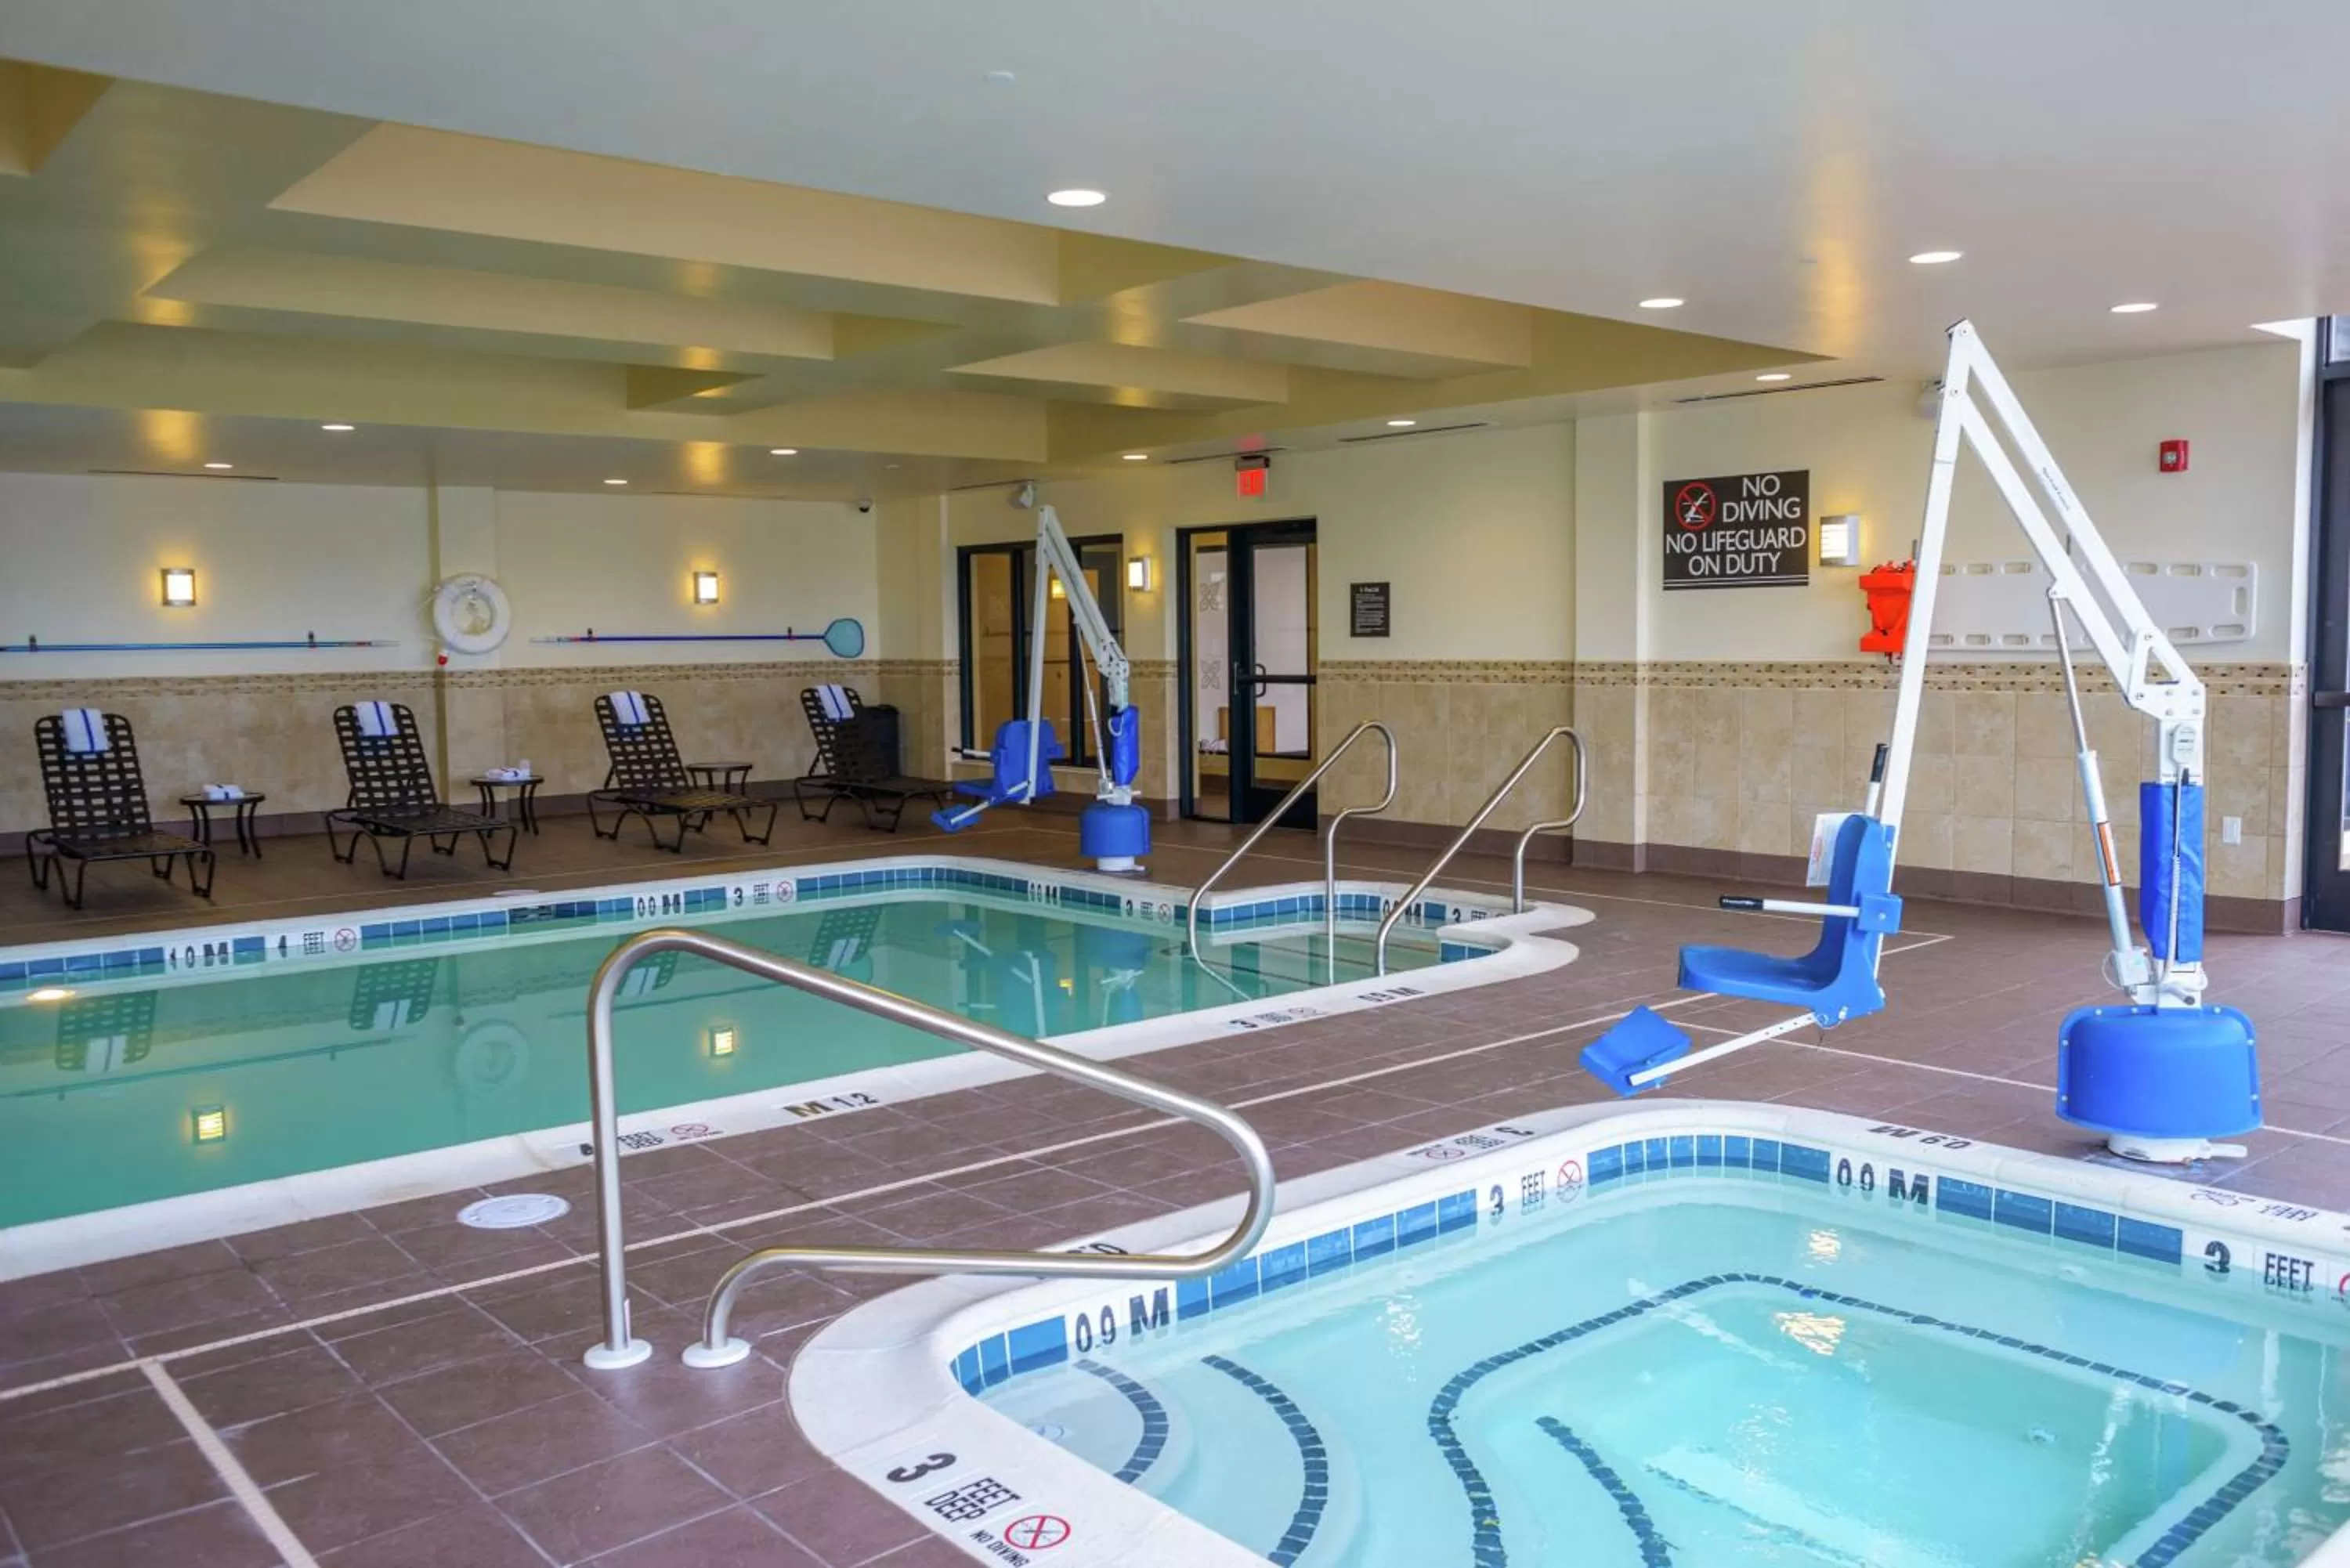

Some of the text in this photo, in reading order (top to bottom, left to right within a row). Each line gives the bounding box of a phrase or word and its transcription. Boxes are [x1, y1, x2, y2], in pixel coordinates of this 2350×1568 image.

[1743, 475, 1781, 497] NO
[1723, 497, 1801, 522] DIVING
[1666, 526, 1806, 554] NO LIFEGUARD
[1688, 552, 1781, 576] ON DUTY
[1889, 1168, 1929, 1205] M
[2204, 1241, 2314, 1292] 3 FEET
[1129, 1287, 1170, 1336] M
[886, 1452, 957, 1483] 3
[924, 1490, 986, 1523] DEEP
[959, 1476, 1022, 1508] FEET
[969, 1529, 1030, 1567] NO DIVING
